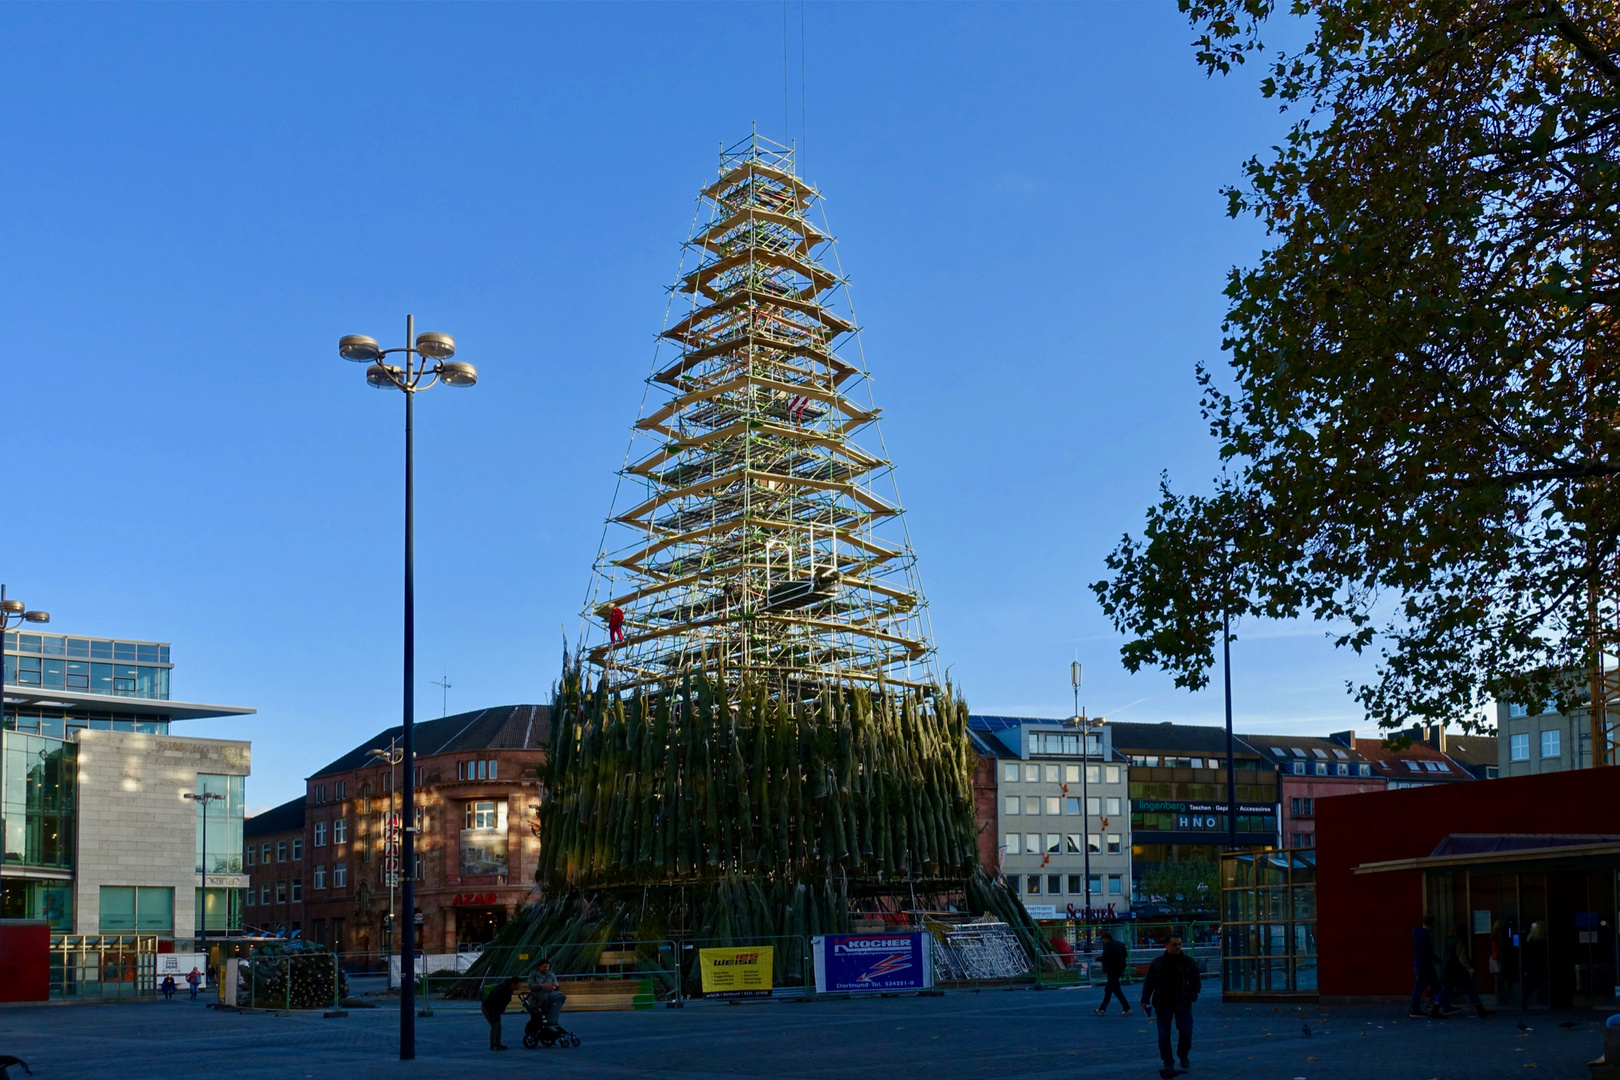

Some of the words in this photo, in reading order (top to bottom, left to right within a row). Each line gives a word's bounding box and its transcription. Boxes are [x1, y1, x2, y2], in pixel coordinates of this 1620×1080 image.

[1139, 800, 1186, 813] lingenberg
[1179, 817, 1216, 828] HNO
[453, 893, 497, 905] AZAD
[849, 939, 912, 949] KOCHER
